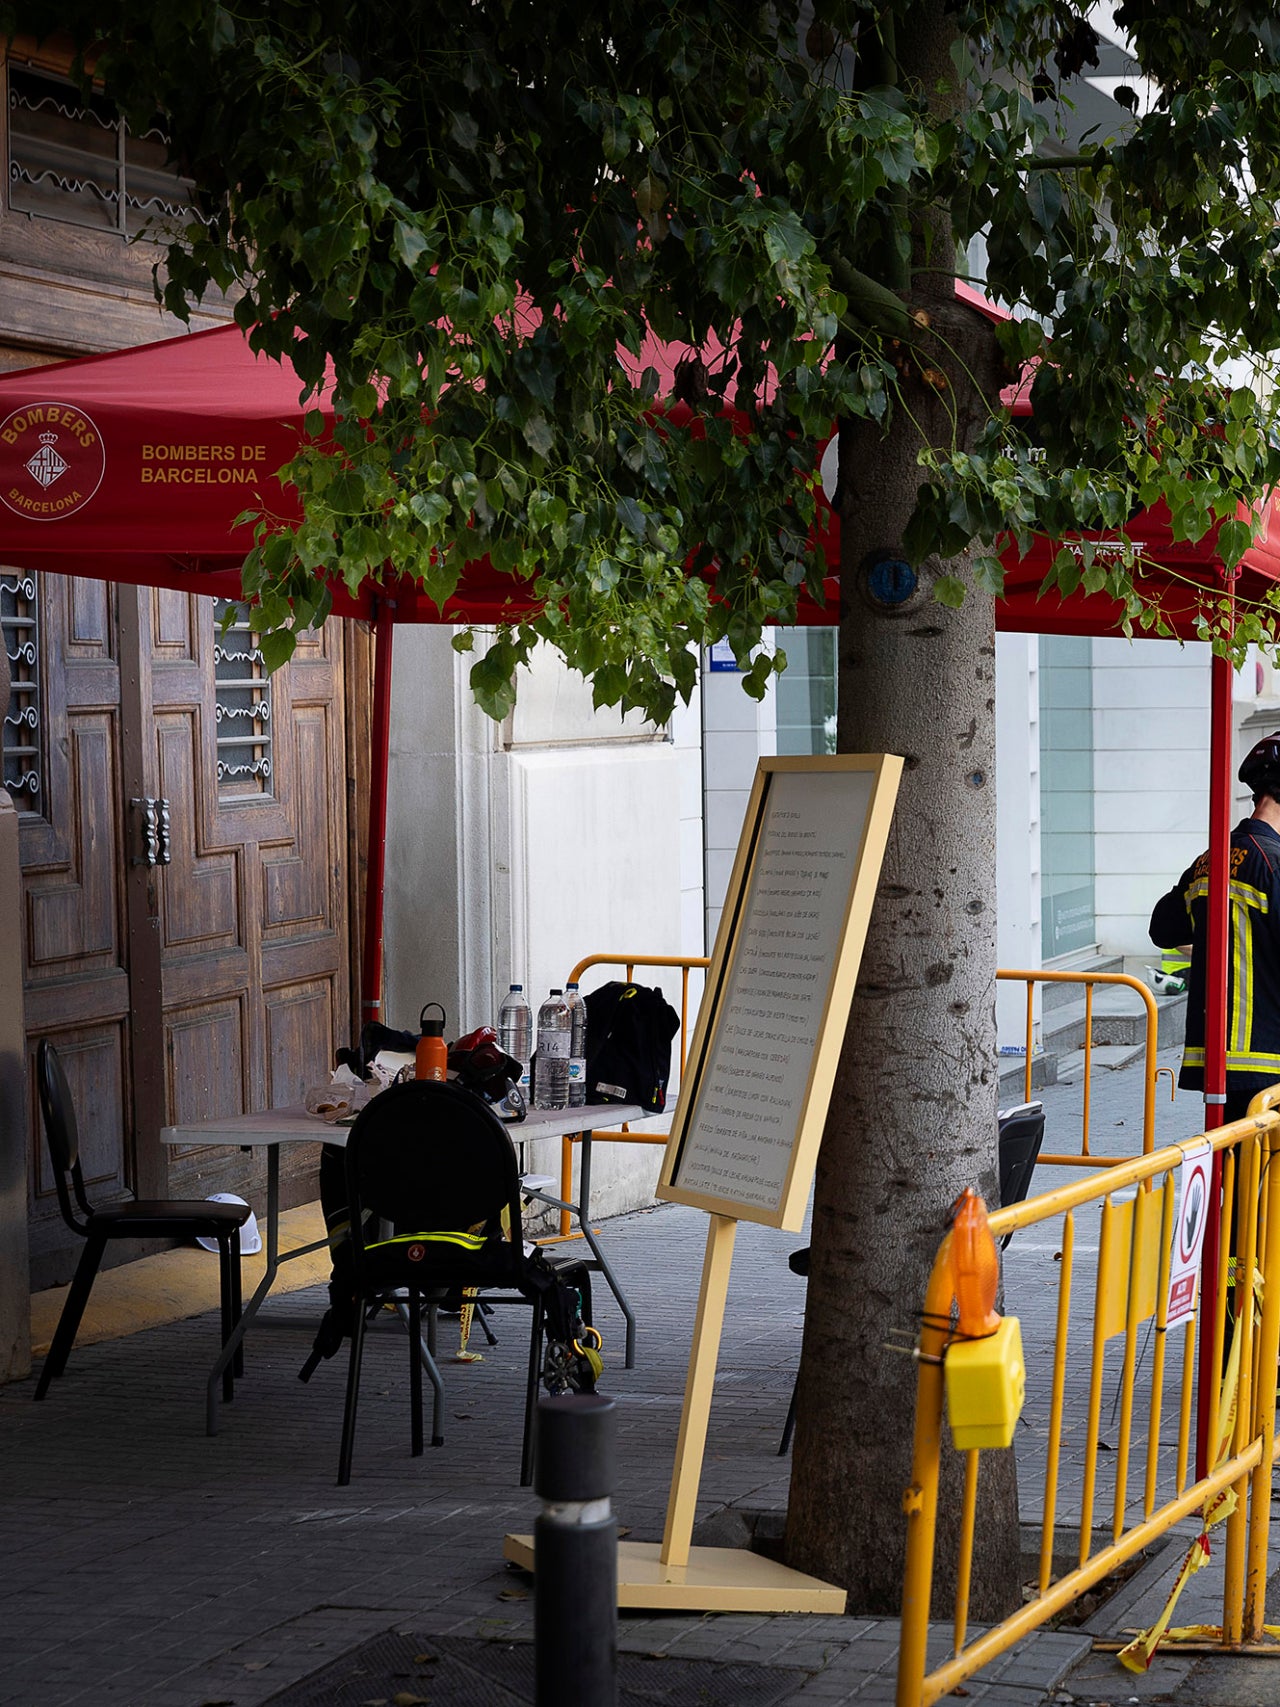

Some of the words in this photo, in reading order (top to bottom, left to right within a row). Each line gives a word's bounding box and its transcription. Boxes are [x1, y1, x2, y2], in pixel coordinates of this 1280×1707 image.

[1, 407, 95, 448] BOMBERS
[142, 445, 235, 460] BOMBERS
[242, 446, 266, 460] DE
[141, 468, 258, 483] BARCELONA
[8, 488, 82, 512] BARCELONA
